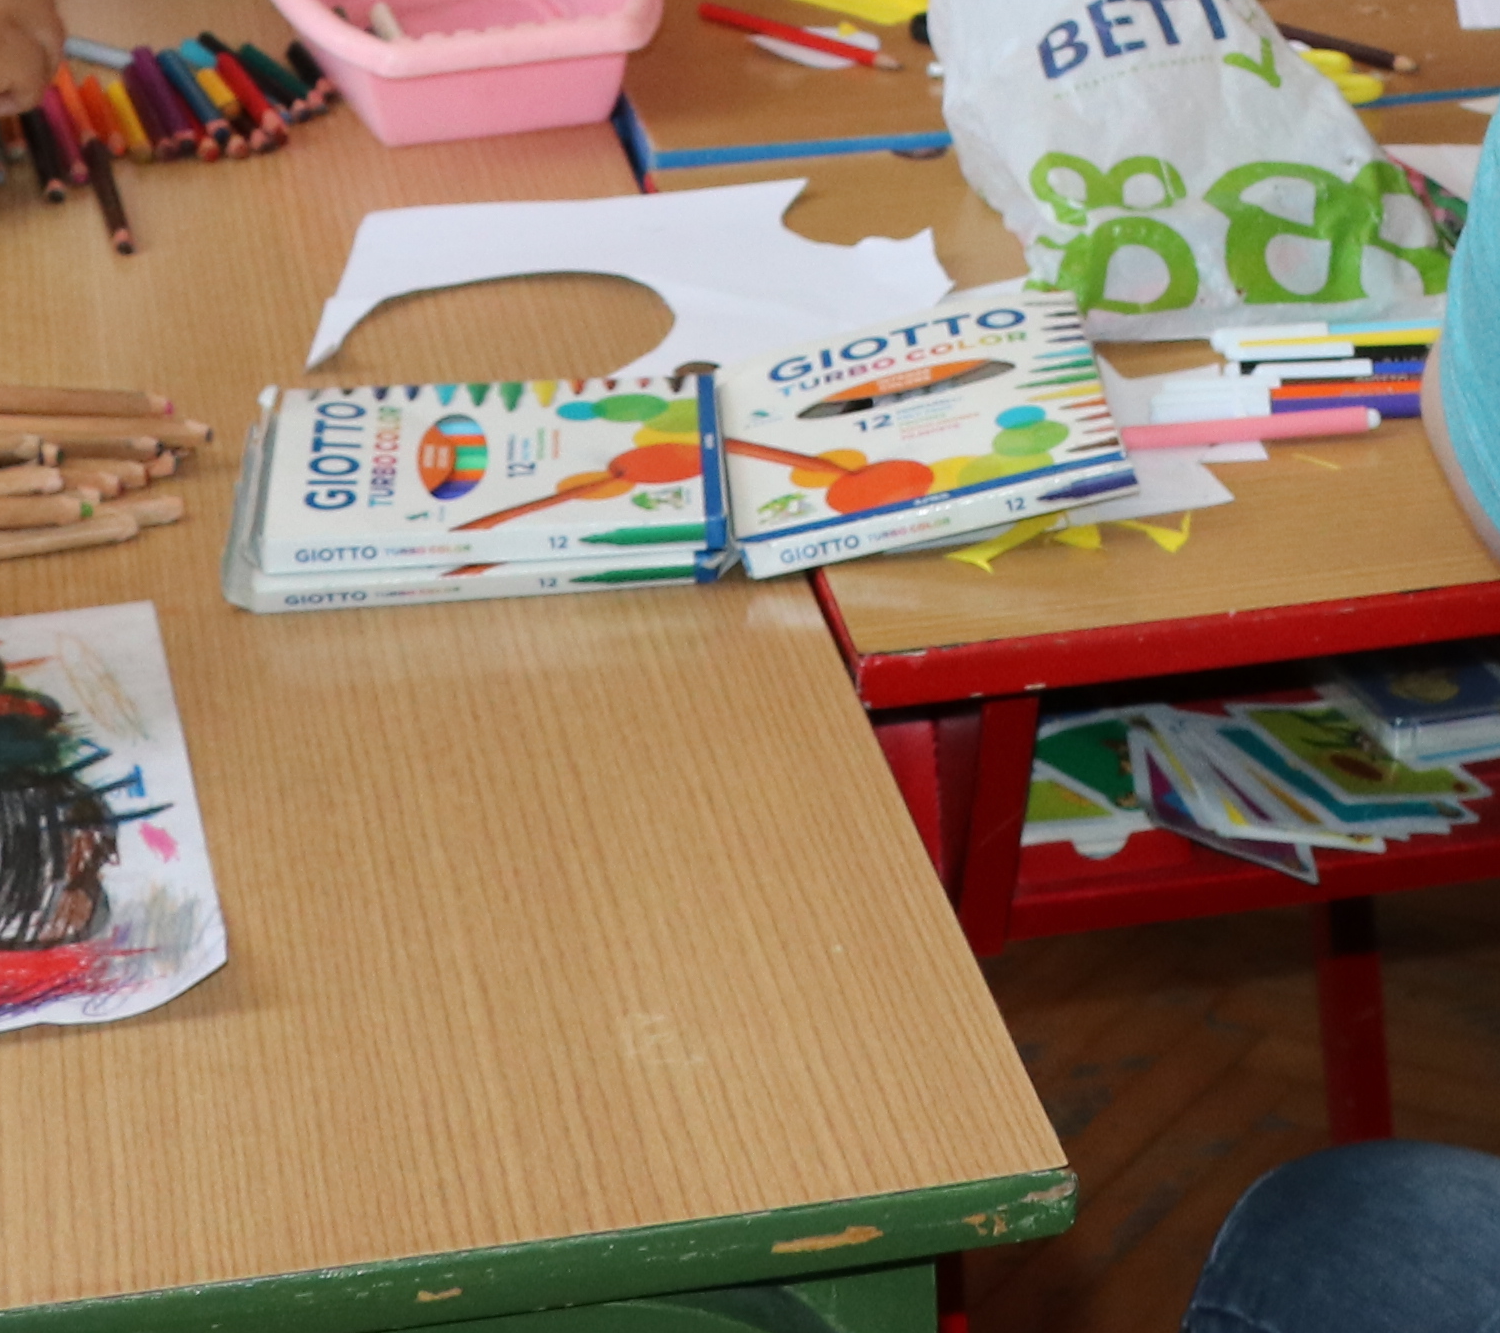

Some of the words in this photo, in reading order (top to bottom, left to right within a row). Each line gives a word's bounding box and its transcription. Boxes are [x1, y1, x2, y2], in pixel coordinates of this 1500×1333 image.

[769, 309, 1026, 382] GIOTTO
[778, 357, 895, 396] TURBO
[906, 332, 1027, 361] COLOR
[375, 406, 402, 453] COLOR
[854, 413, 892, 433] 12
[304, 402, 366, 511] GIOTTO
[368, 454, 398, 507] TURBO
[295, 544, 377, 564] GIOTTO
[549, 535, 569, 550] 12
[781, 536, 860, 564] GIOTTO
[1005, 497, 1026, 513] 12
[285, 589, 367, 607] GIOTTO
[539, 576, 558, 589] 12
